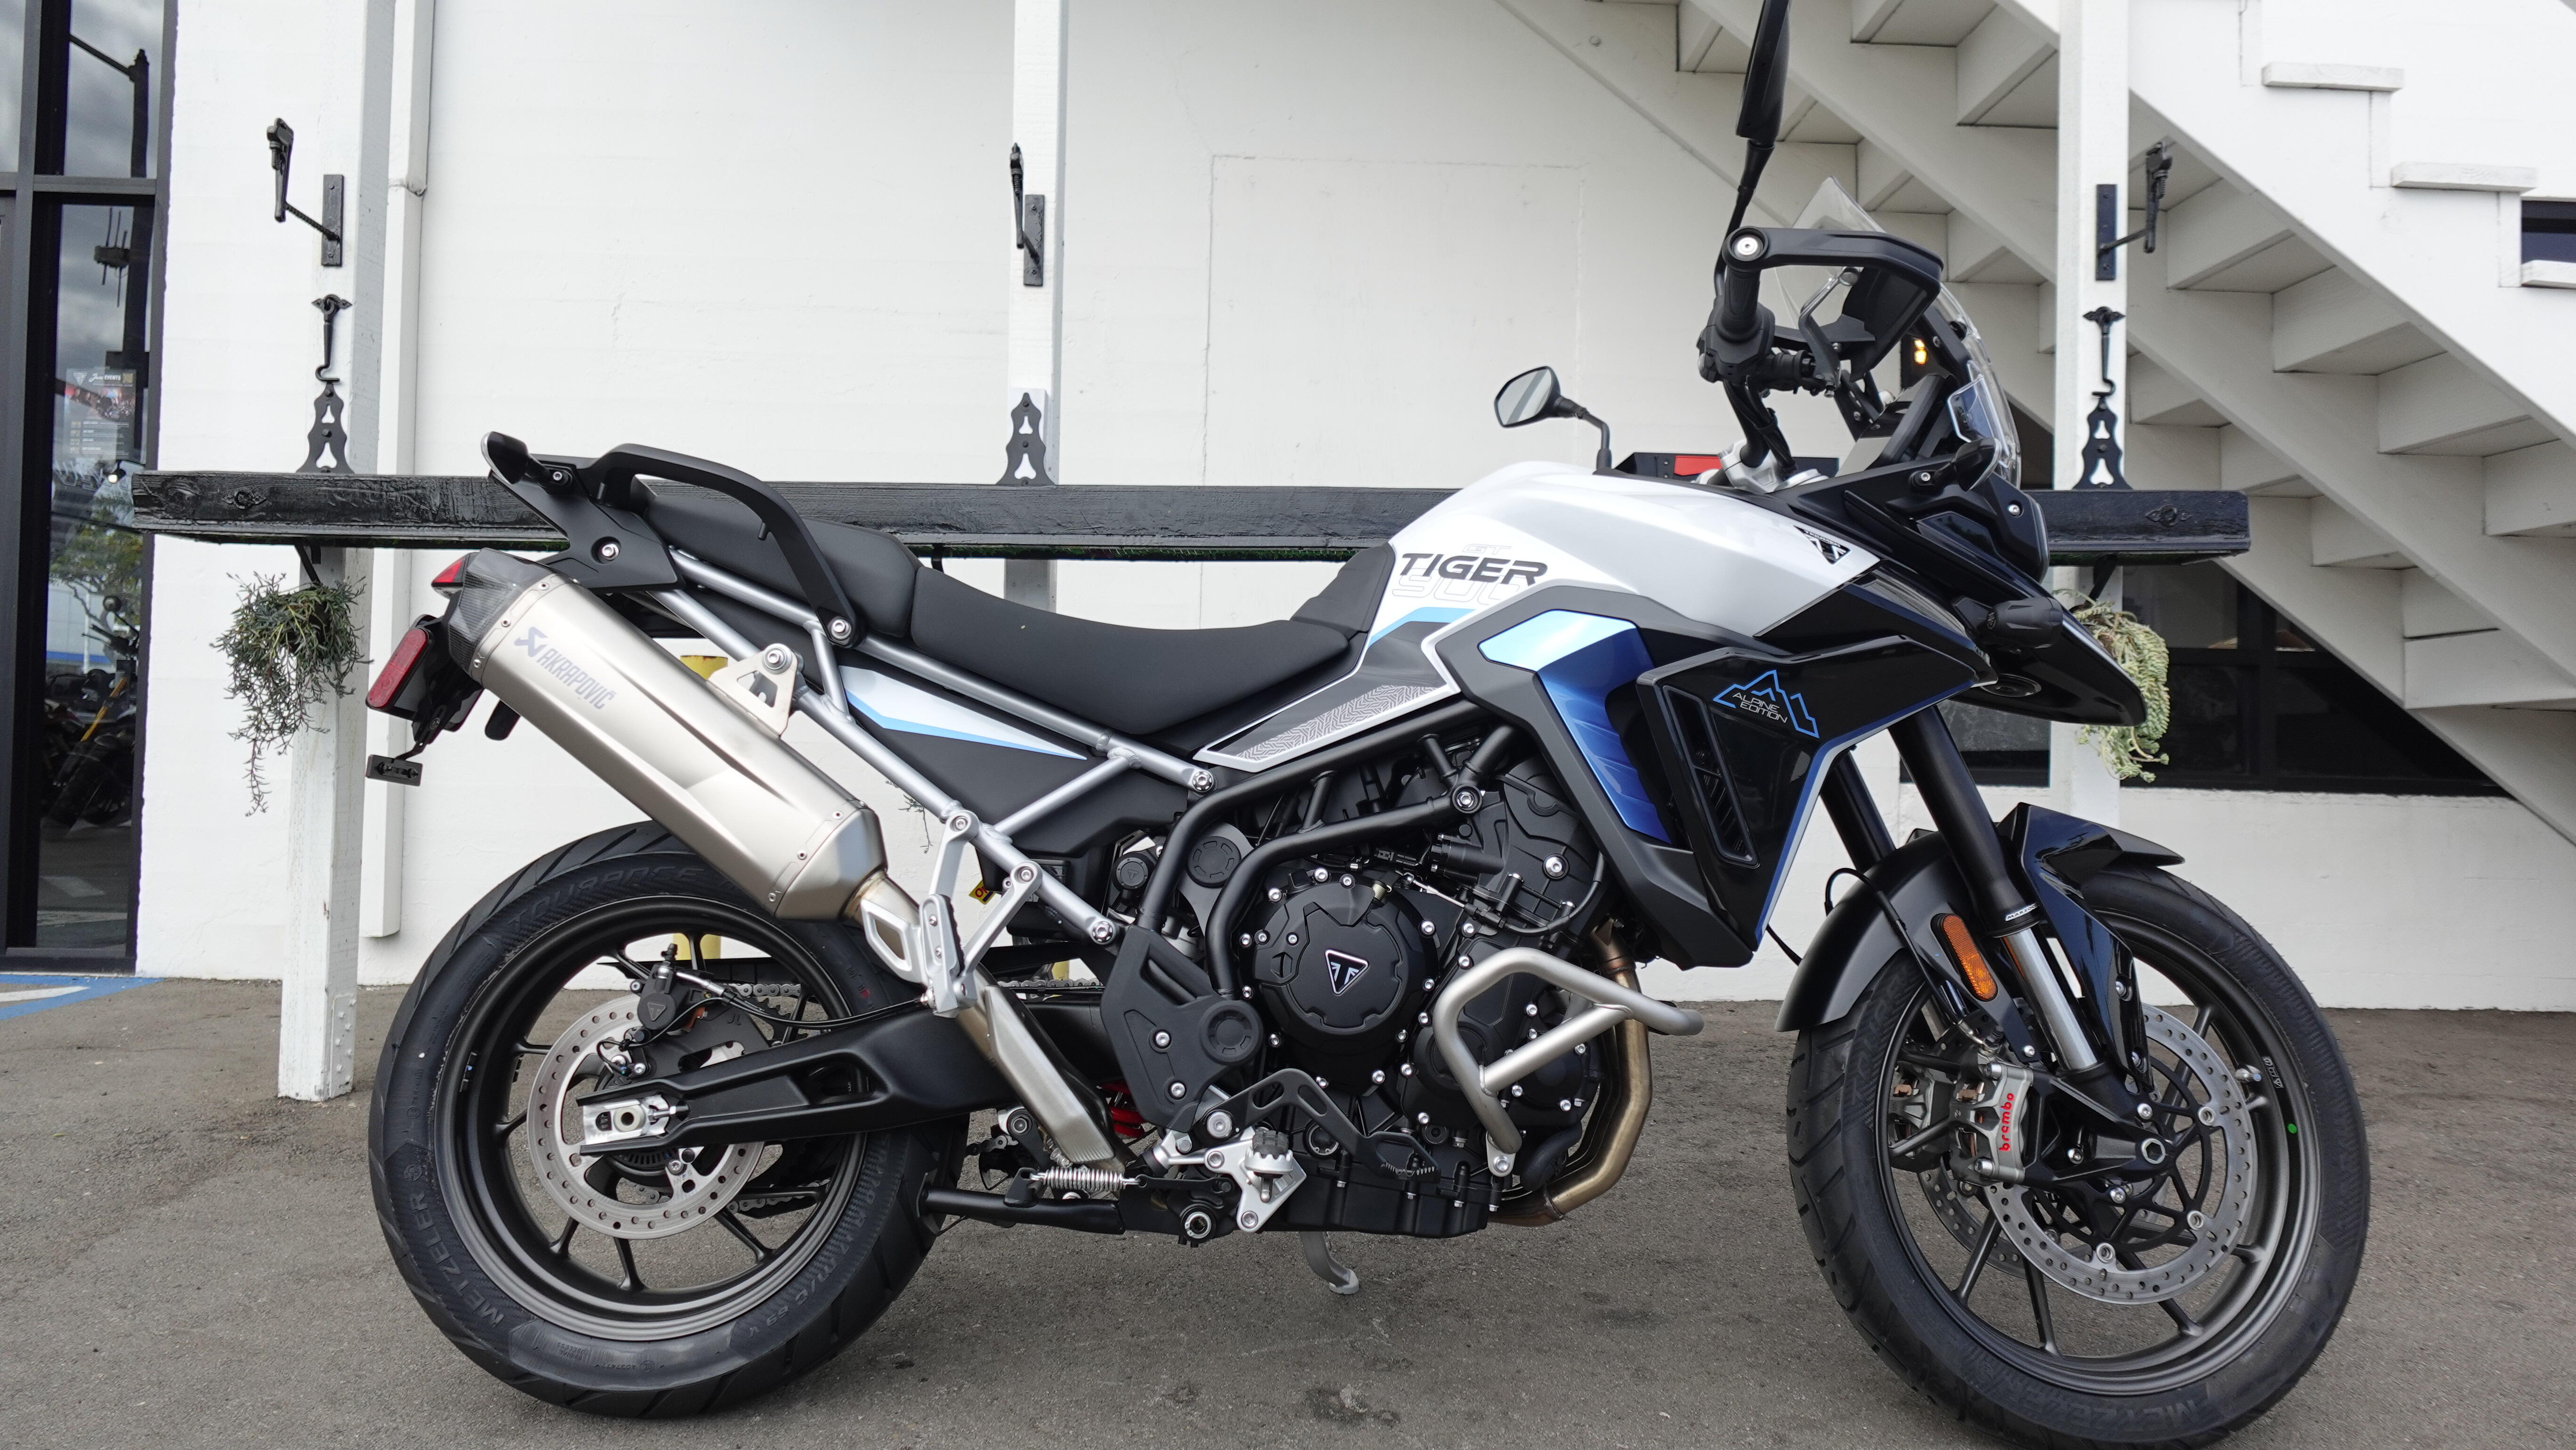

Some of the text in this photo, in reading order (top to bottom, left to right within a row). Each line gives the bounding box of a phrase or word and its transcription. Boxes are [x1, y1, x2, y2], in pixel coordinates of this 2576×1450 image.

[1462, 544, 1512, 555] GT
[1400, 553, 1548, 587] TIGER
[1732, 692, 1780, 713] ALPINE
[1740, 701, 1788, 723] EDITION
[1998, 1093, 2015, 1152] brembo
[410, 1192, 505, 1328] METZELER
